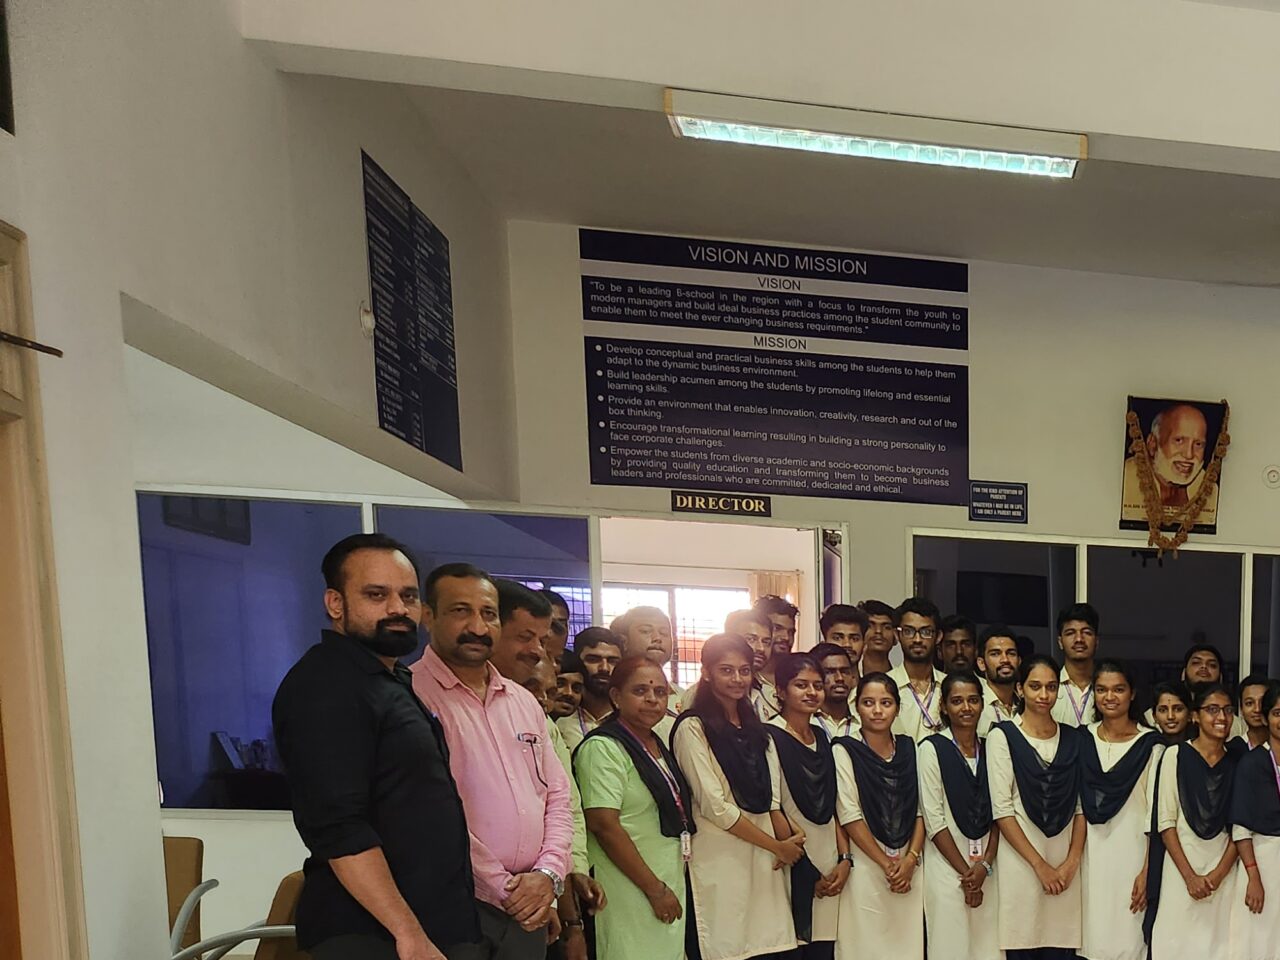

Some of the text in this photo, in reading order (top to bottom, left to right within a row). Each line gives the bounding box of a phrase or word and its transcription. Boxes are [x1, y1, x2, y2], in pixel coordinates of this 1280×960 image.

[688, 246, 866, 274] VISION AND MISSION
[757, 276, 800, 291] VISION
[590, 294, 950, 332] modern managers and build ideal business practices among student community
[638, 285, 671, 298] leading
[676, 288, 714, 299] B-school
[732, 293, 747, 302] the
[752, 295, 779, 306] region
[784, 298, 802, 306] with
[818, 299, 841, 310] focus
[860, 304, 900, 315] transform
[905, 307, 919, 316] the
[924, 311, 947, 319] youth
[590, 305, 622, 314] enable
[624, 306, 646, 316] them
[660, 310, 683, 319] meet
[685, 311, 699, 320] the
[701, 314, 721, 322] ever
[723, 314, 763, 327] changing
[765, 317, 804, 329] business
[753, 335, 806, 349] MISSION
[606, 343, 956, 378] Develop conceptual and practical business skills among the students help them
[606, 355, 798, 377] adapt dynamic business environment.
[606, 369, 950, 402] Build leadership acumen among the students promoting lifelong and essential
[607, 380, 669, 393] learning skills.
[608, 395, 957, 428] Provide environment that enables innovation, creativity, research and out the
[608, 406, 664, 420] box thinking.
[610, 420, 936, 452] Encourage transformational learning resulting building strong personality
[610, 431, 725, 448] face corporate challenges.
[610, 445, 949, 476] Empower students from diverse academic and socio-economic backgrounds
[627, 459, 949, 486] providing quality education and transforming them become business
[611, 467, 643, 477] leaders
[646, 470, 662, 478] and
[664, 471, 722, 482] professionals
[724, 474, 743, 483] who
[761, 476, 809, 488] committed,
[811, 480, 852, 490] dedicated
[854, 483, 871, 492] and
[872, 484, 903, 493] ethical.
[676, 495, 766, 512] DIRECTOR
